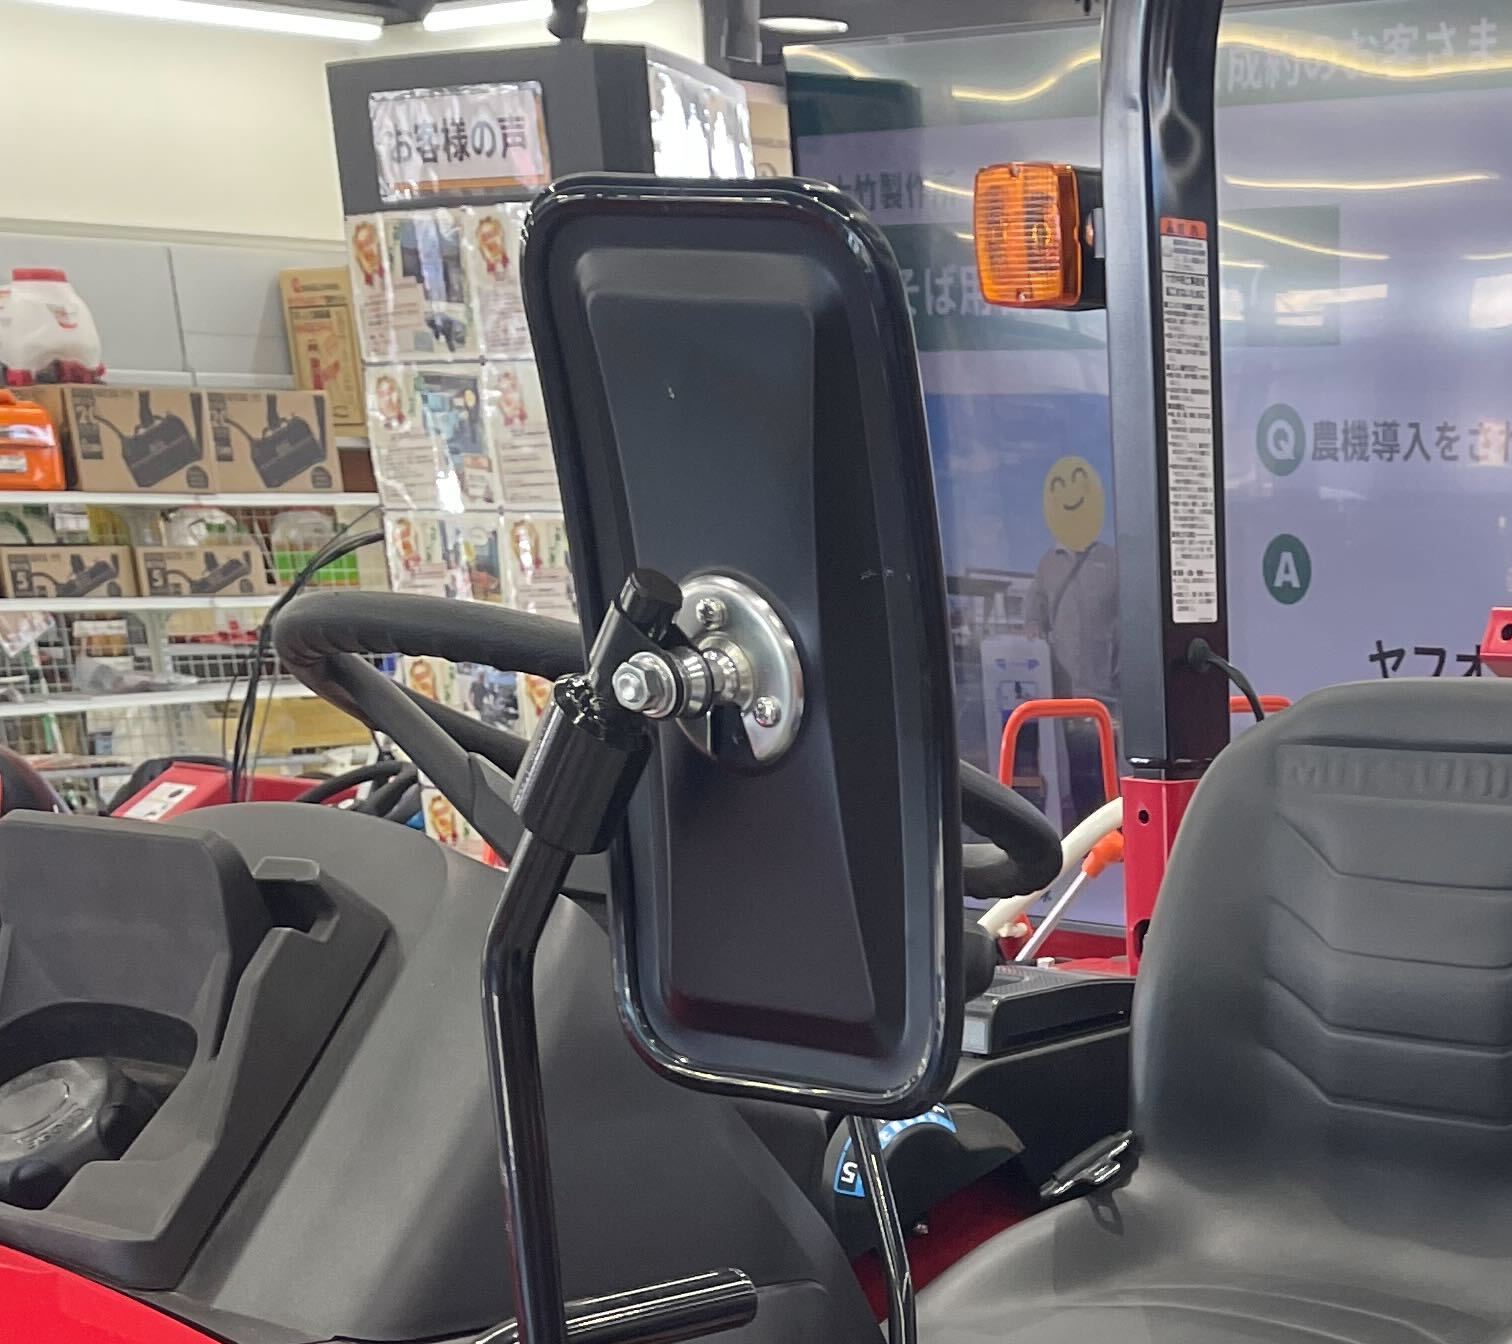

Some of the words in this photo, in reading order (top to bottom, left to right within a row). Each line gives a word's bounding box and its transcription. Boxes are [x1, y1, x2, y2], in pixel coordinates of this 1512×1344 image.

[391, 115, 527, 163] お客様の声
[1267, 424, 1296, 461] Q
[1274, 551, 1300, 589] A
